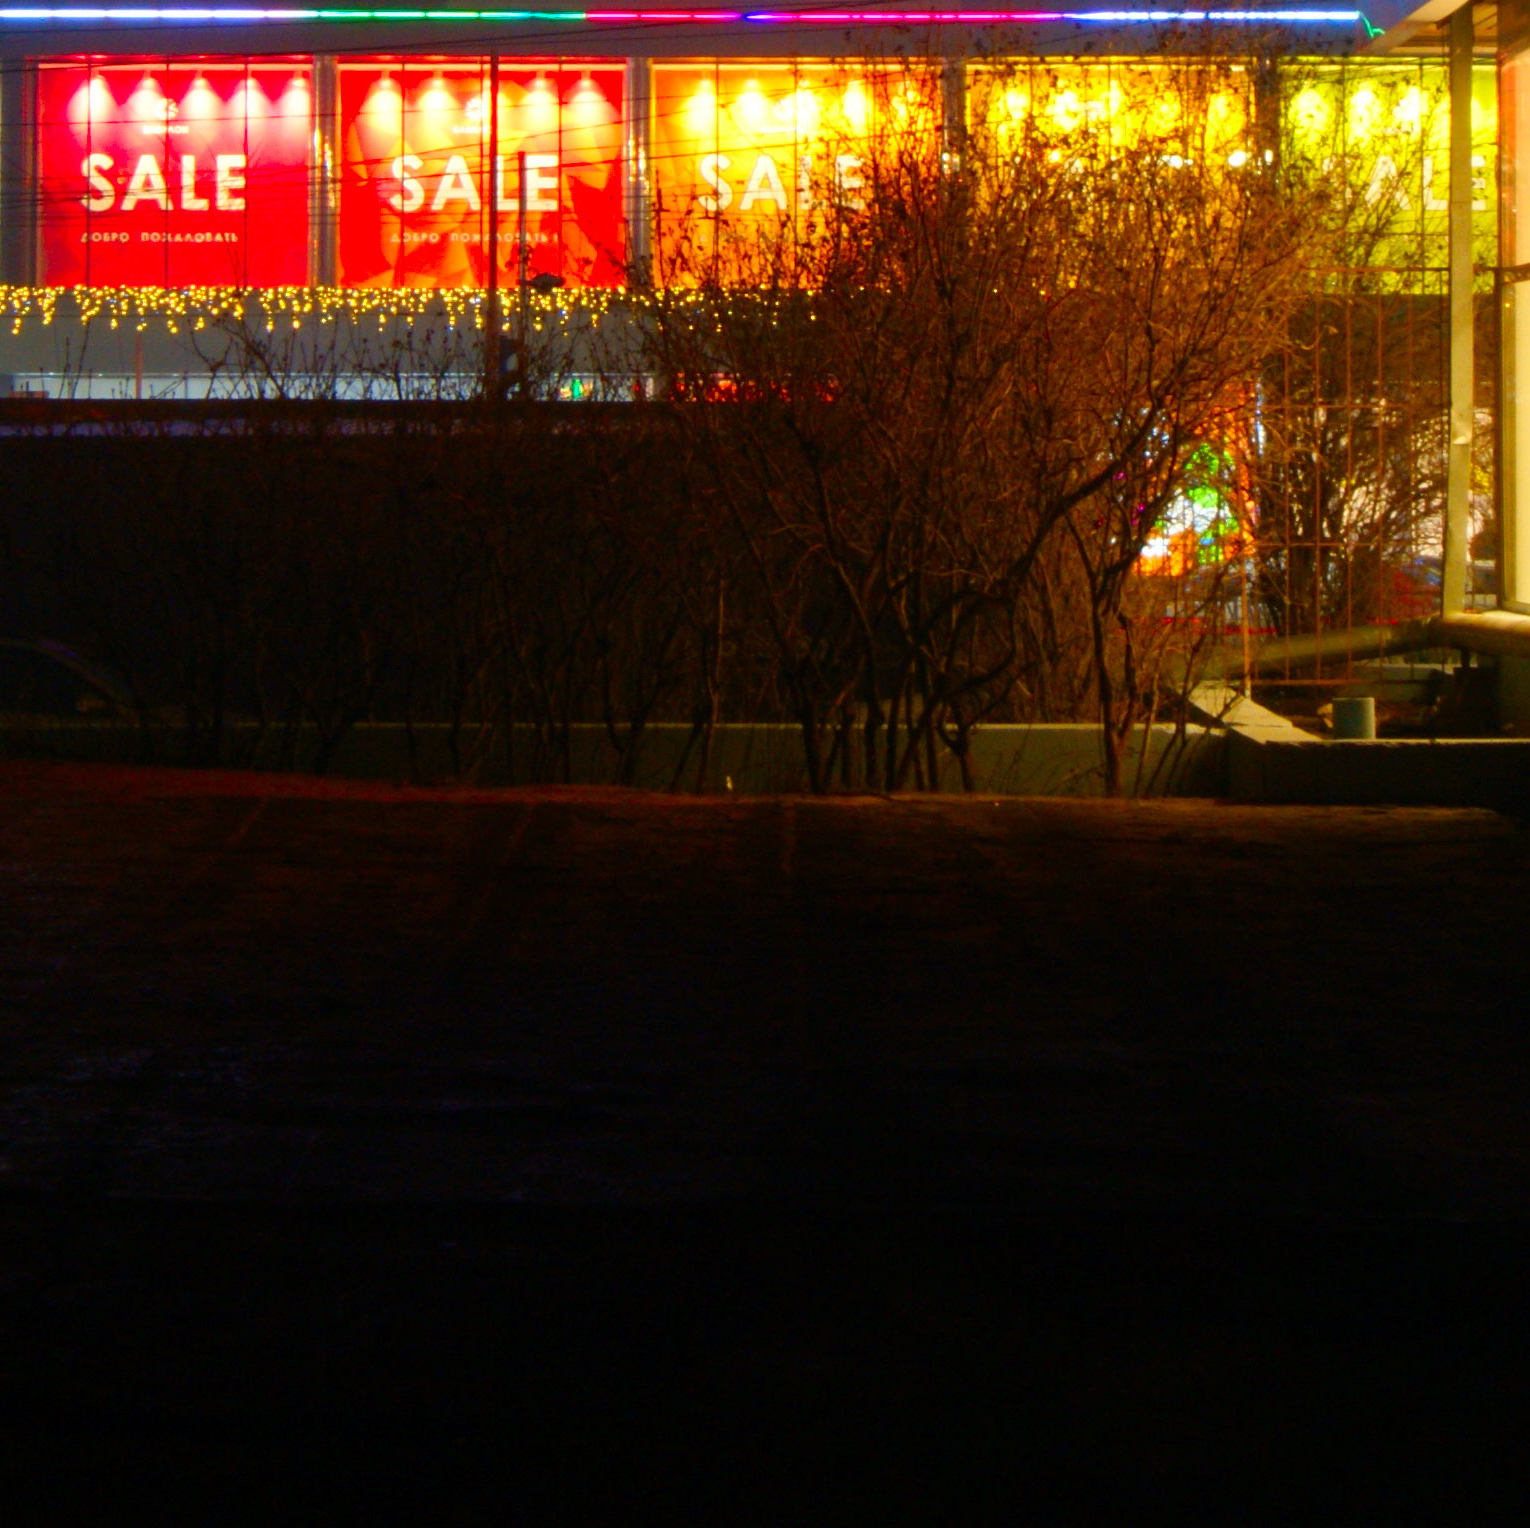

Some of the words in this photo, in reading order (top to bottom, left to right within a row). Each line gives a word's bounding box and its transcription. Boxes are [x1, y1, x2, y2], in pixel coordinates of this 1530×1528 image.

[80, 153, 246, 212] SALE
[389, 154, 559, 212] SALE
[698, 153, 867, 212] SALE
